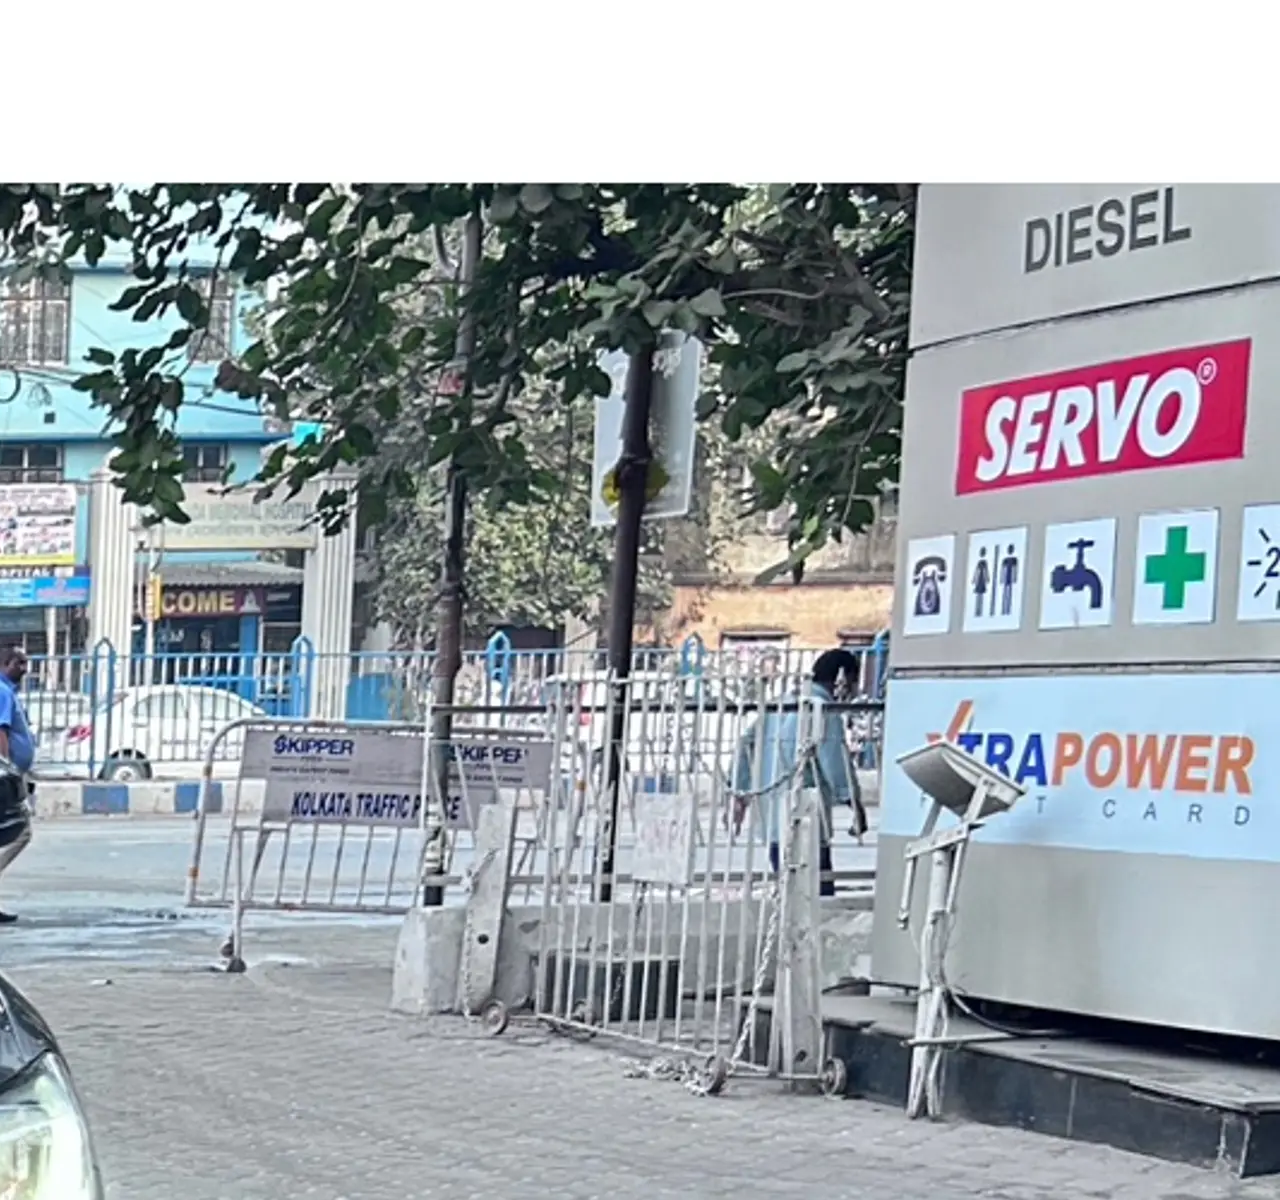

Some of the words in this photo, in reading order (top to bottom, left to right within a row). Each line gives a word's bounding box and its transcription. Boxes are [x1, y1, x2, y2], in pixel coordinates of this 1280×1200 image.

[1024, 187, 1191, 273] DIESEL
[975, 367, 1202, 482] SERVO
[273, 734, 354, 756] SKIPPER
[292, 792, 351, 816] KOLKATA
[356, 793, 410, 819] TRAFFIC
